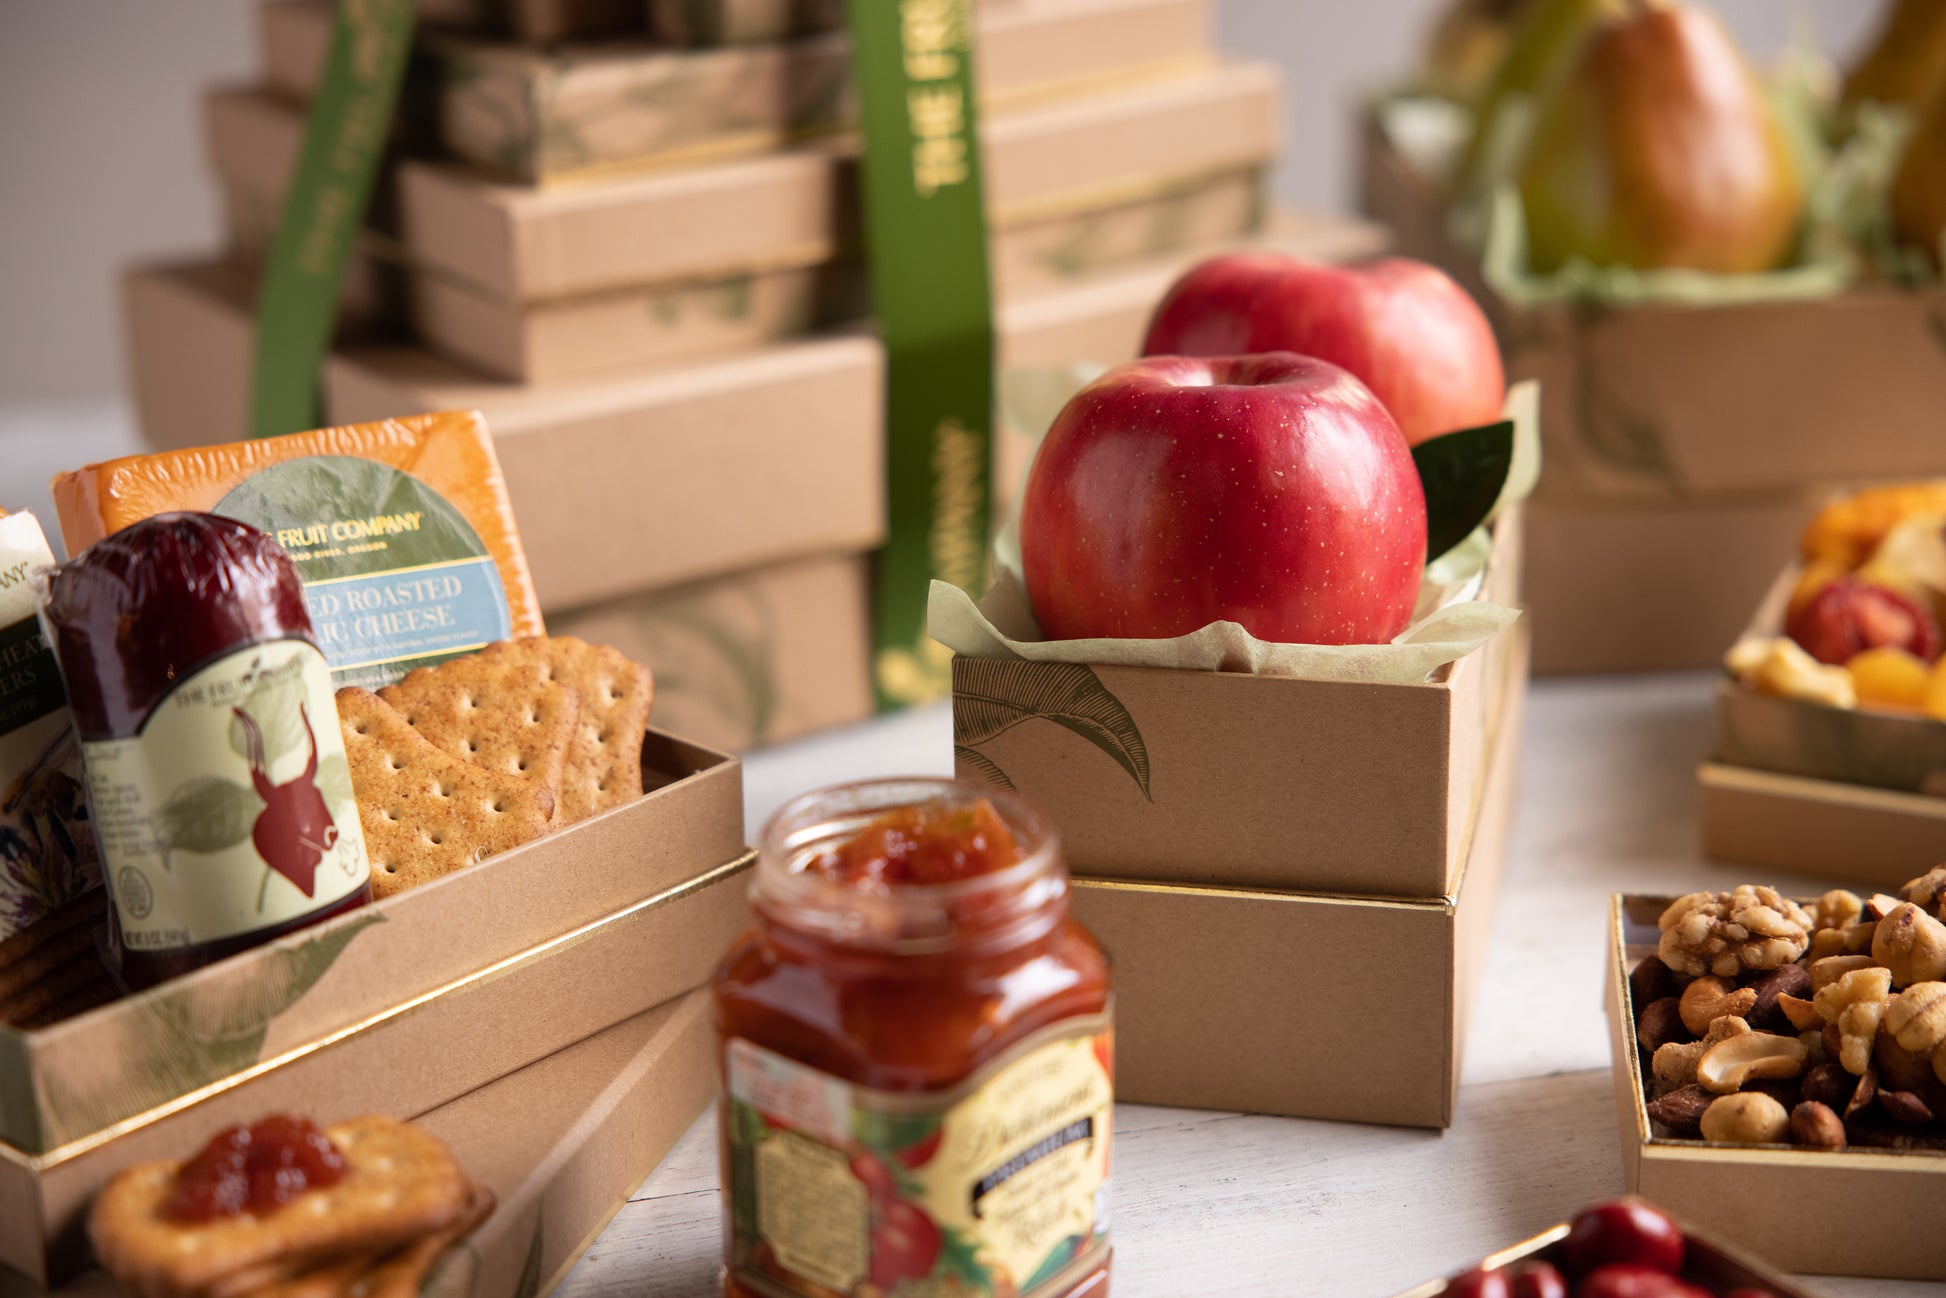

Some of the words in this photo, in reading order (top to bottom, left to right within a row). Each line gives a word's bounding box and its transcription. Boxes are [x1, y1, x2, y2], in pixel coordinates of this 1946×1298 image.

[906, 82, 969, 199] THE
[277, 523, 328, 548] FRUIT
[331, 511, 421, 541] COMPANY
[345, 575, 463, 612] ROASTED
[320, 621, 349, 646] IC
[354, 605, 456, 638] CHEESE
